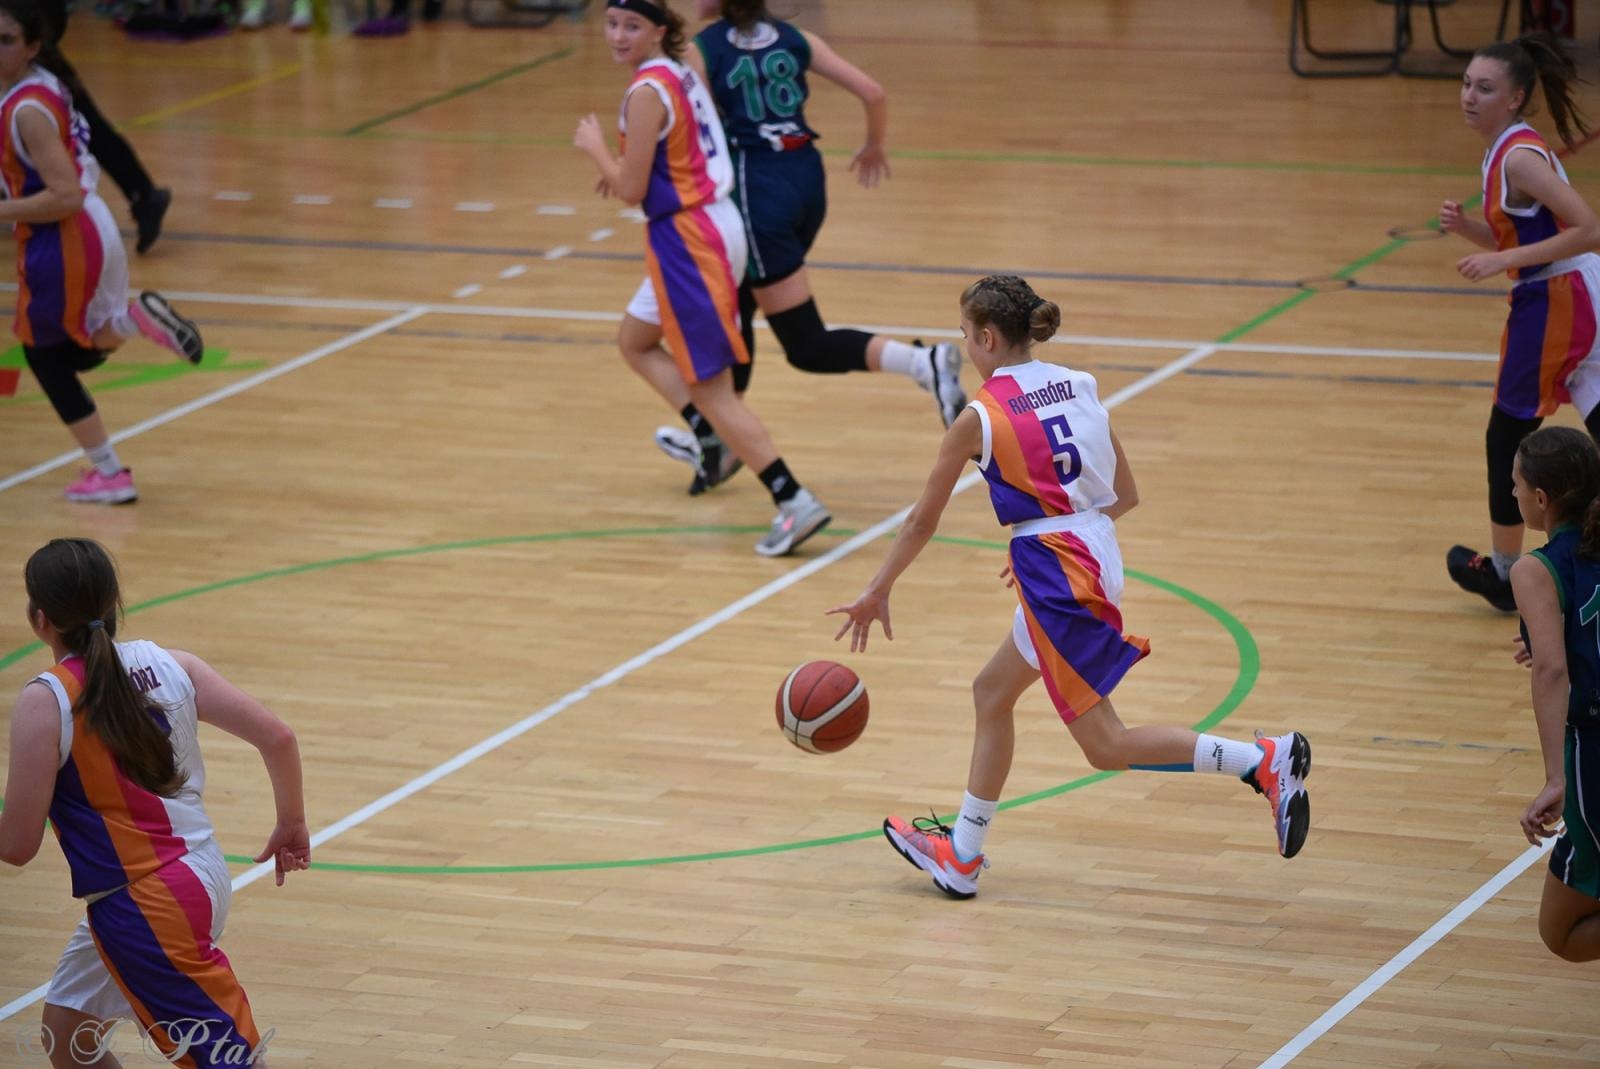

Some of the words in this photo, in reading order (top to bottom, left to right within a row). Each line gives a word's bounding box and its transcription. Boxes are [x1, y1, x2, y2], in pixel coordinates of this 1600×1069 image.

[726, 49, 804, 122] 18
[1007, 379, 1076, 416] RACIBÓRZ
[1040, 414, 1083, 486] 5
